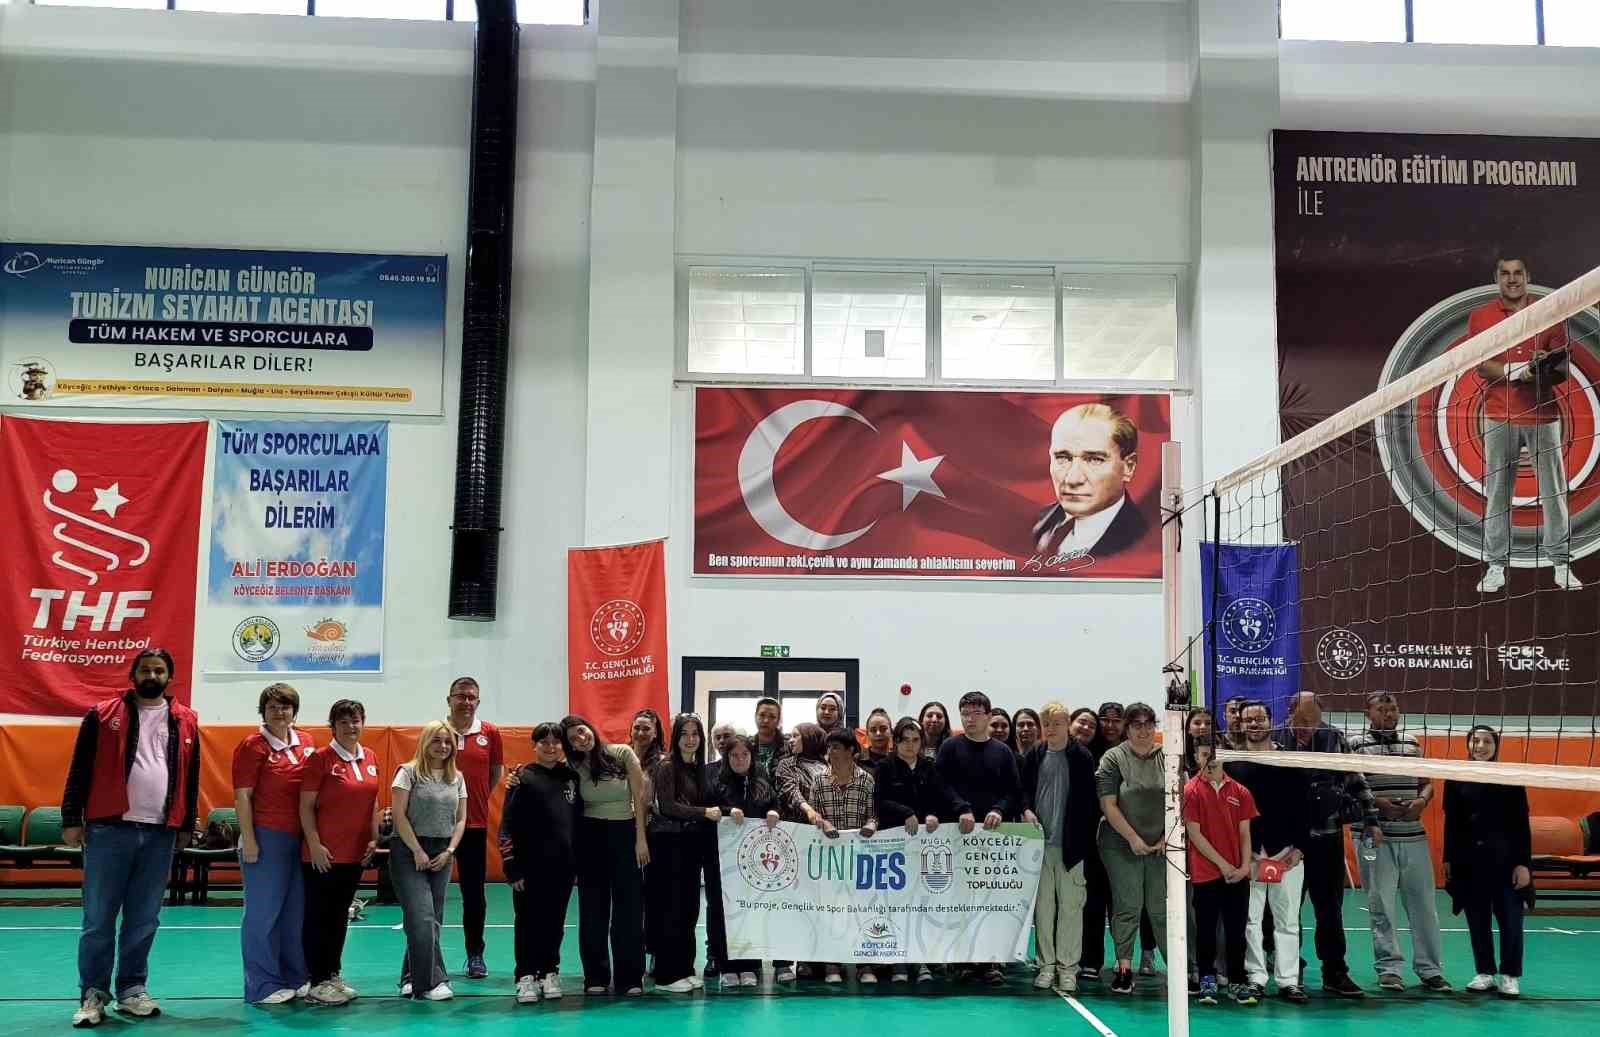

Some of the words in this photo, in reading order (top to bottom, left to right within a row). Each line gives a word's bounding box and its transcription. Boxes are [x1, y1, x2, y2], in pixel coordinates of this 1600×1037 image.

[1296, 153, 1398, 183] ANTRENÖR
[1402, 154, 1468, 184] EĞİTİM
[1473, 159, 1577, 186] PROGRAMI
[1298, 187, 1324, 215] İLE
[144, 264, 230, 291] NURİCAN
[237, 265, 317, 294] GÜNGÖR
[70, 288, 156, 319] TURİZM
[162, 293, 261, 322] SEYAHAT
[267, 297, 374, 326] ACENTASI
[87, 322, 127, 340] TÜM
[131, 326, 196, 342] HAKEM
[201, 328, 223, 343] VE
[228, 328, 349, 346] SPORCULARA
[134, 352, 245, 373] BAŞARILAR
[253, 353, 314, 373] DİLER!
[221, 428, 258, 455] TÜM
[262, 432, 380, 456] SPORCULARA
[250, 468, 349, 495] BAŞARILAR
[264, 500, 335, 528] DİLERİM
[231, 559, 261, 577] ALİ
[266, 559, 356, 577] ERDOĞAN
[709, 553, 728, 567] Ben
[730, 554, 785, 569] sporcunun
[836, 557, 848, 569] ve
[850, 557, 872, 570] aynı
[873, 556, 918, 569] zamanda
[975, 558, 1016, 571] severim
[30, 588, 153, 631] THF
[22, 634, 82, 651] Türkiye
[85, 635, 150, 650] Hentbol
[1372, 644, 1395, 654] T.C.
[1455, 646, 1473, 655] VE
[21, 649, 126, 667] Federasyonu
[602, 656, 639, 670] GENÇLİK
[641, 655, 652, 663] VE
[1373, 658, 1406, 668] SPOR
[1408, 657, 1473, 669] BAKANLIĞI
[582, 671, 607, 681] SPOR
[607, 664, 655, 679] BAKANLIĞI
[963, 836, 1022, 847] KÖYCEĞİZ
[965, 851, 1017, 862] GENÇLİK
[965, 866, 980, 875] VE
[984, 865, 1018, 875] DOĞA
[967, 879, 1023, 889] TOPLULUĞU
[827, 903, 844, 914] Spor
